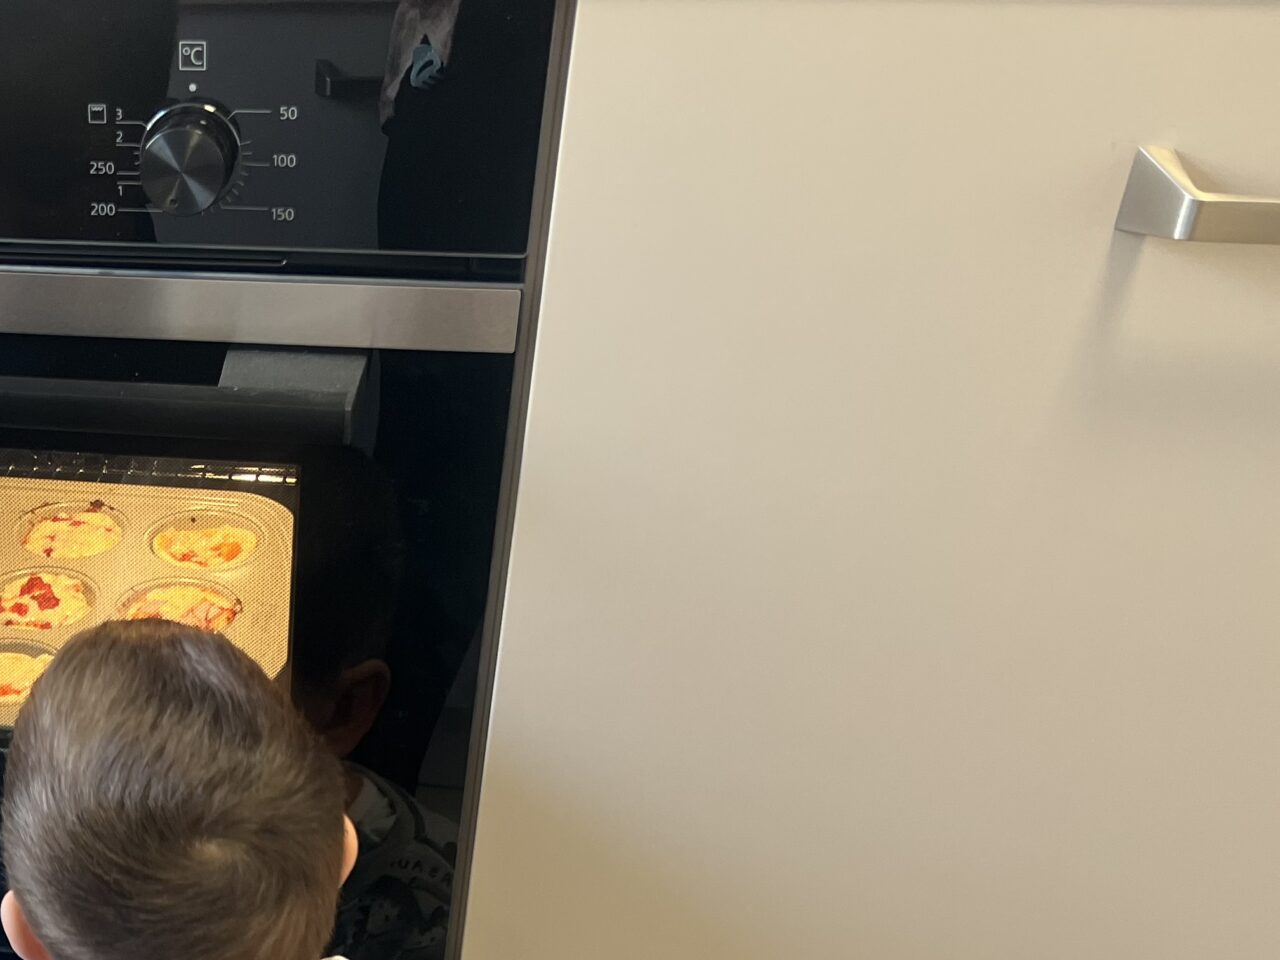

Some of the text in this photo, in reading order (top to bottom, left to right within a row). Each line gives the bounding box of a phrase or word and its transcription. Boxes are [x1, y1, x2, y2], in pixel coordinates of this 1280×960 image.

[115, 108, 123, 120] 3
[279, 106, 298, 120] 50
[115, 131, 123, 143] 2
[272, 154, 297, 168] 100
[89, 161, 115, 175] 250
[117, 185, 123, 197] 1
[90, 203, 116, 216] 200
[271, 208, 295, 221] 150
